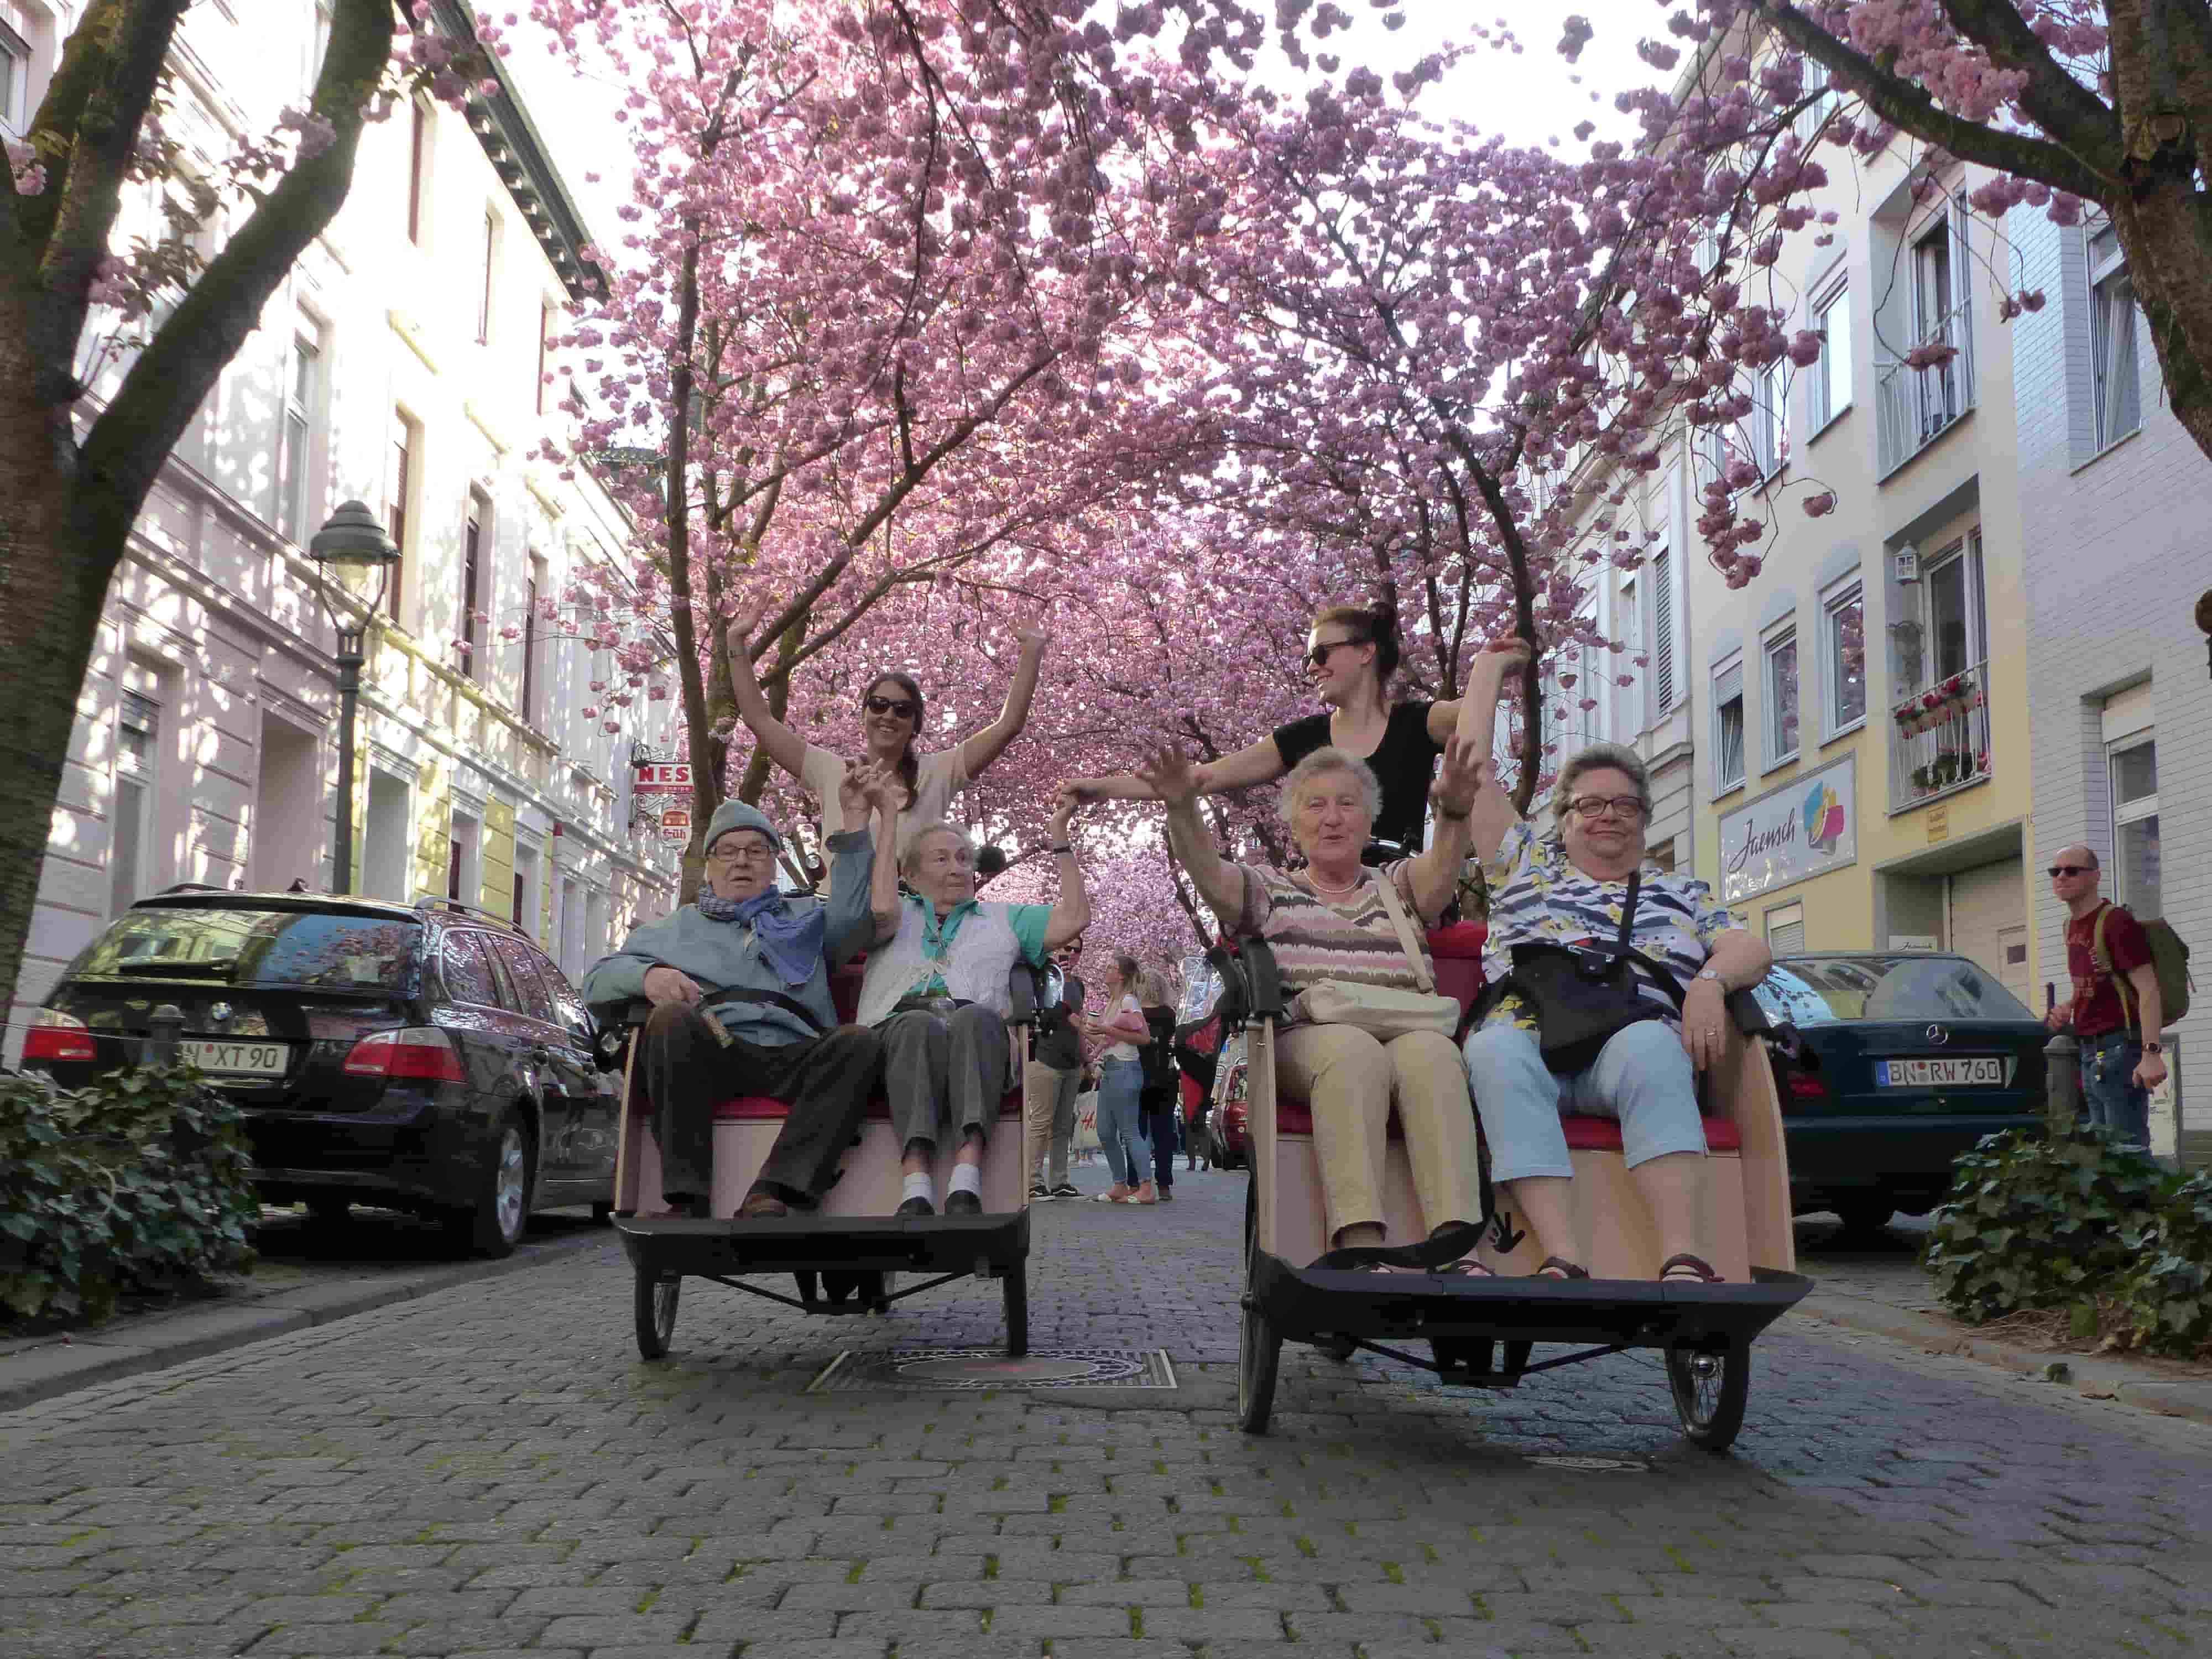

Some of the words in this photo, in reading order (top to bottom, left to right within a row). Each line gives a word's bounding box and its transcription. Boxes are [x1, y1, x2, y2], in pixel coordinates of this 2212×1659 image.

[638, 766, 689, 782] NES
[1728, 807, 1795, 873] Jaensch
[214, 1045, 244, 1067] XT
[249, 1047, 279, 1069] 90
[1889, 1062, 1917, 1082] BN
[1929, 1062, 1956, 1082] RW
[1960, 1060, 1999, 1081] 760
